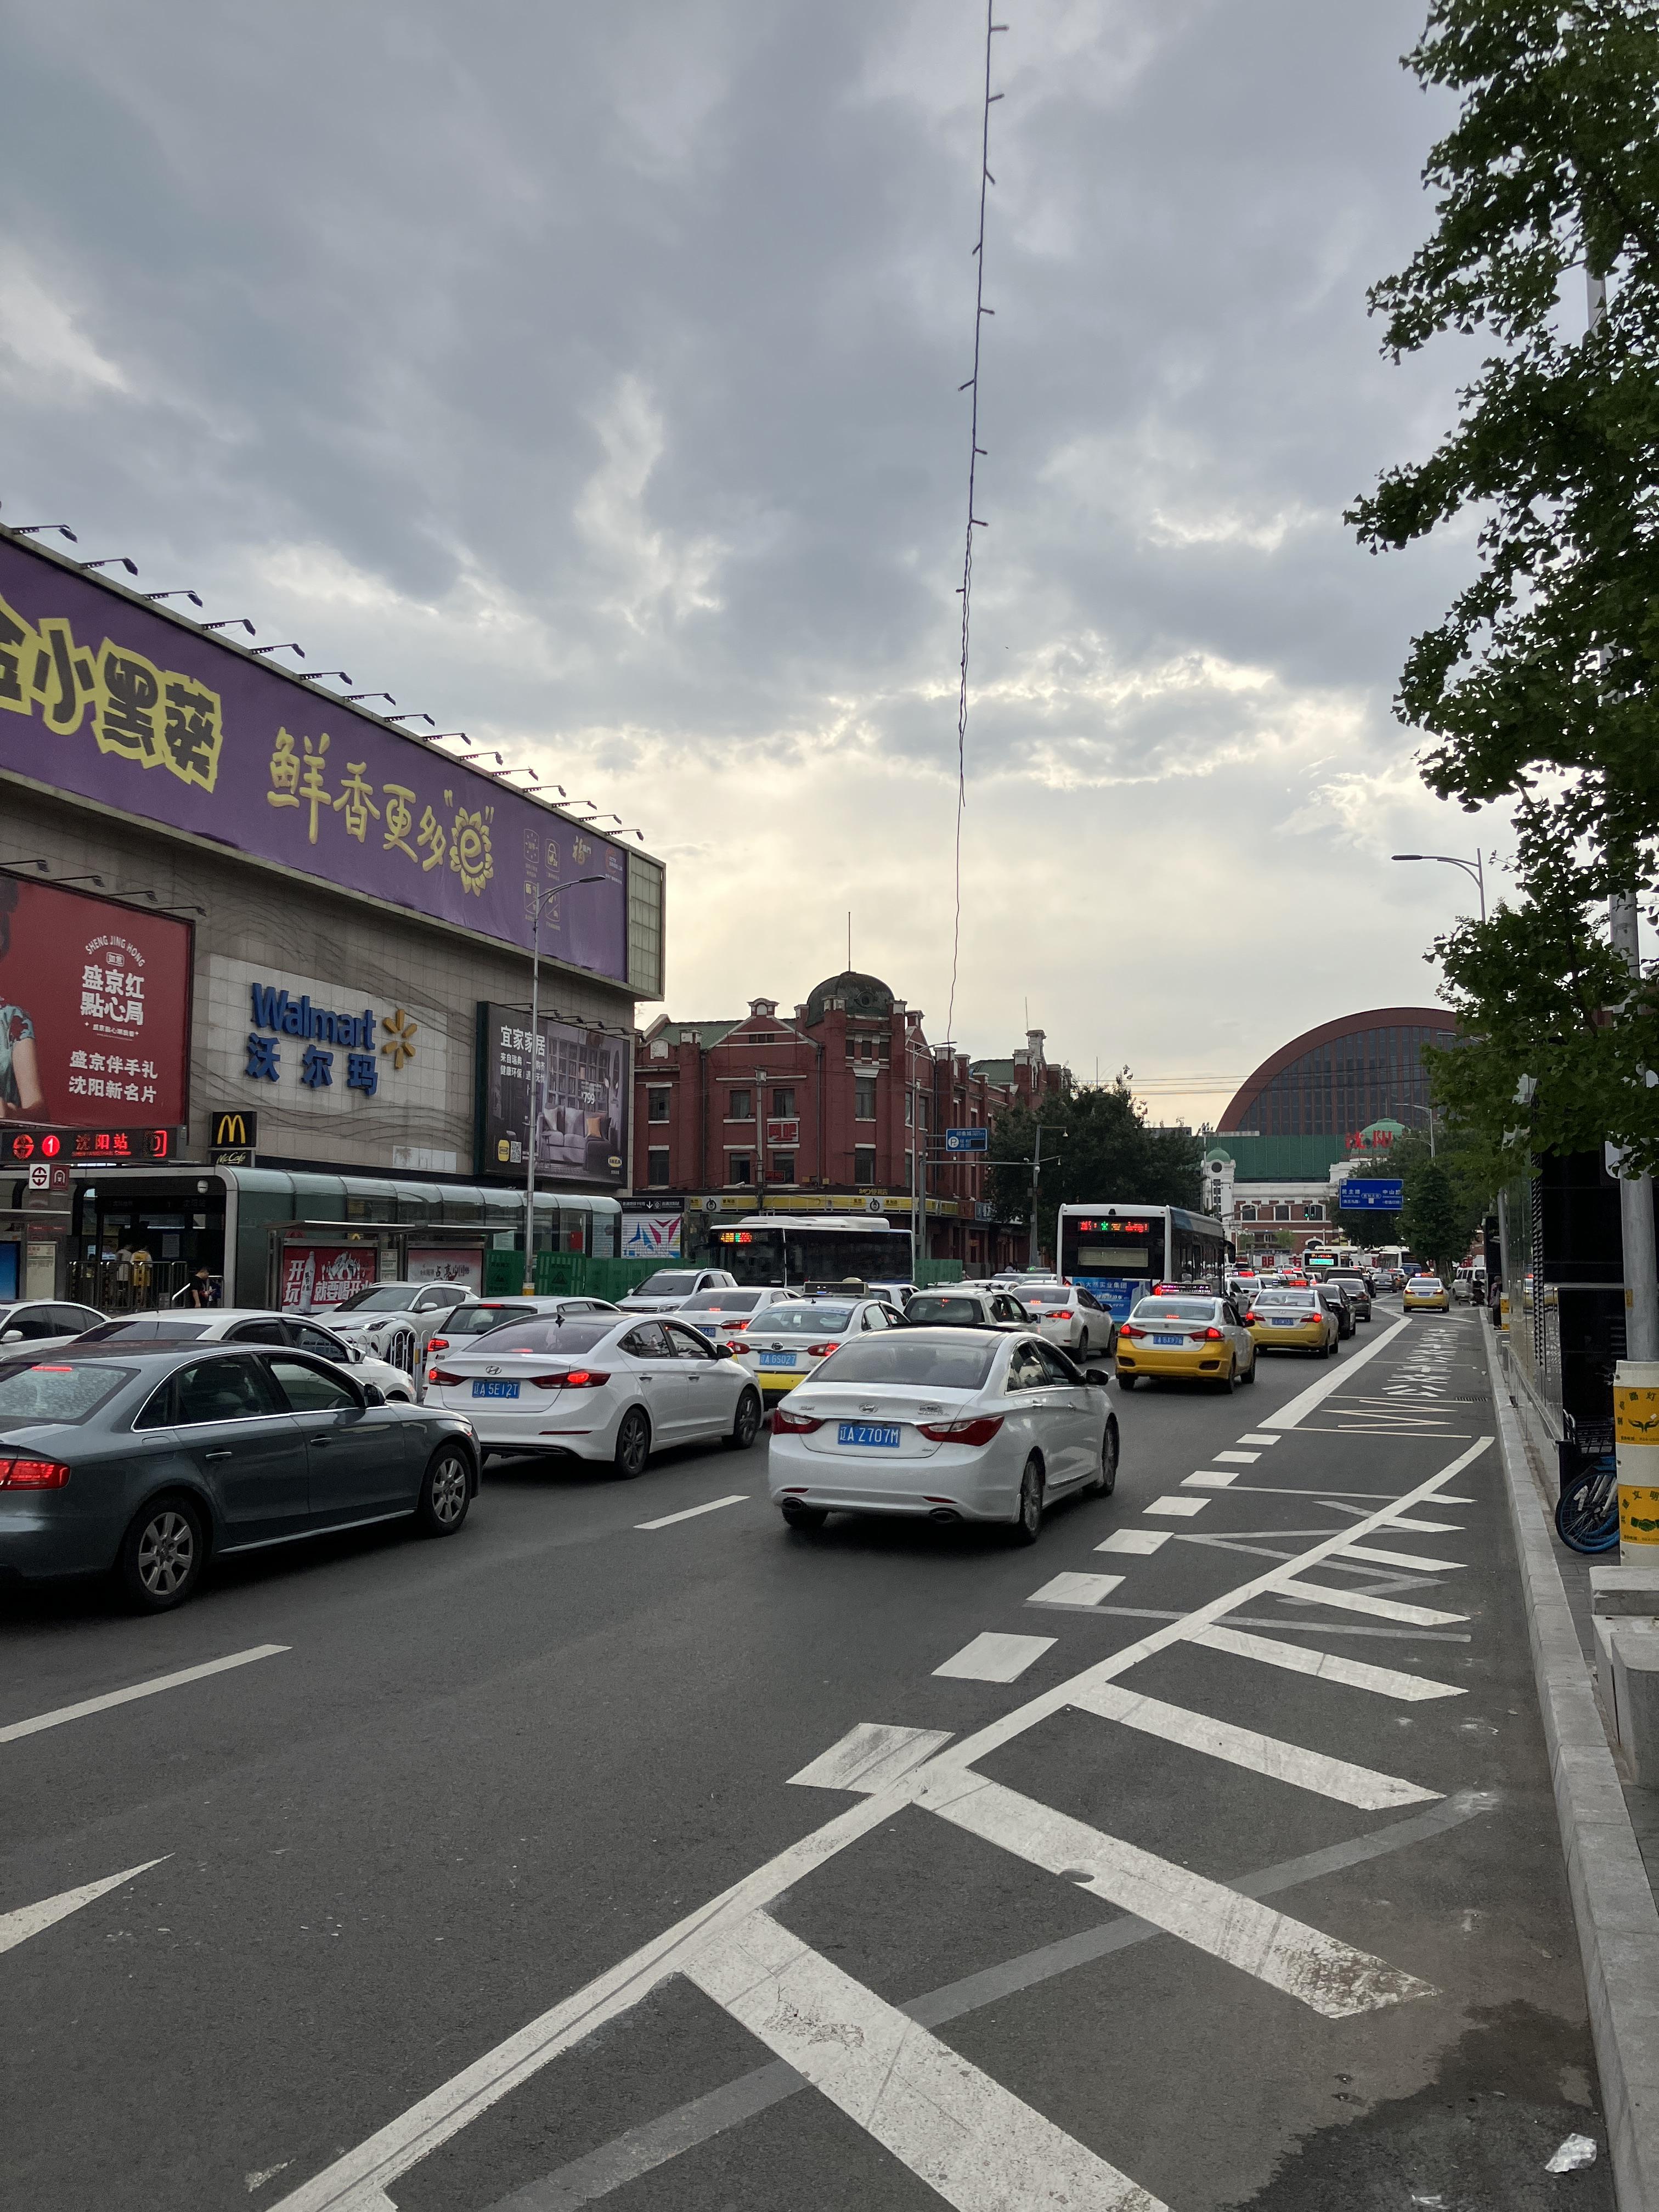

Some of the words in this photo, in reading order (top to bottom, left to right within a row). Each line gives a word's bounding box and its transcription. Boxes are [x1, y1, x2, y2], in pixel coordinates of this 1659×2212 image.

[85, 935, 108, 955] SHENG
[110, 935, 126, 949] JING
[126, 943, 145, 967] HONG
[82, 964, 145, 999] 盛京红
[80, 991, 144, 1025] 點心局
[252, 982, 376, 1050] Walmart
[500, 1025, 545, 1057] 宜家家居
[69, 1049, 158, 1080] 盛京伴手礼
[246, 1032, 379, 1096] 沃尔玛
[500, 1052, 522, 1066] 来自瑞典
[500, 1065, 522, 1079] 健康环保
[69, 1075, 157, 1103] 沈阳新名片
[48, 1138, 54, 1153] 1
[76, 1132, 128, 1150] 沈阳站
[288, 1260, 305, 1280] 开
[284, 1282, 301, 1302] 玩
